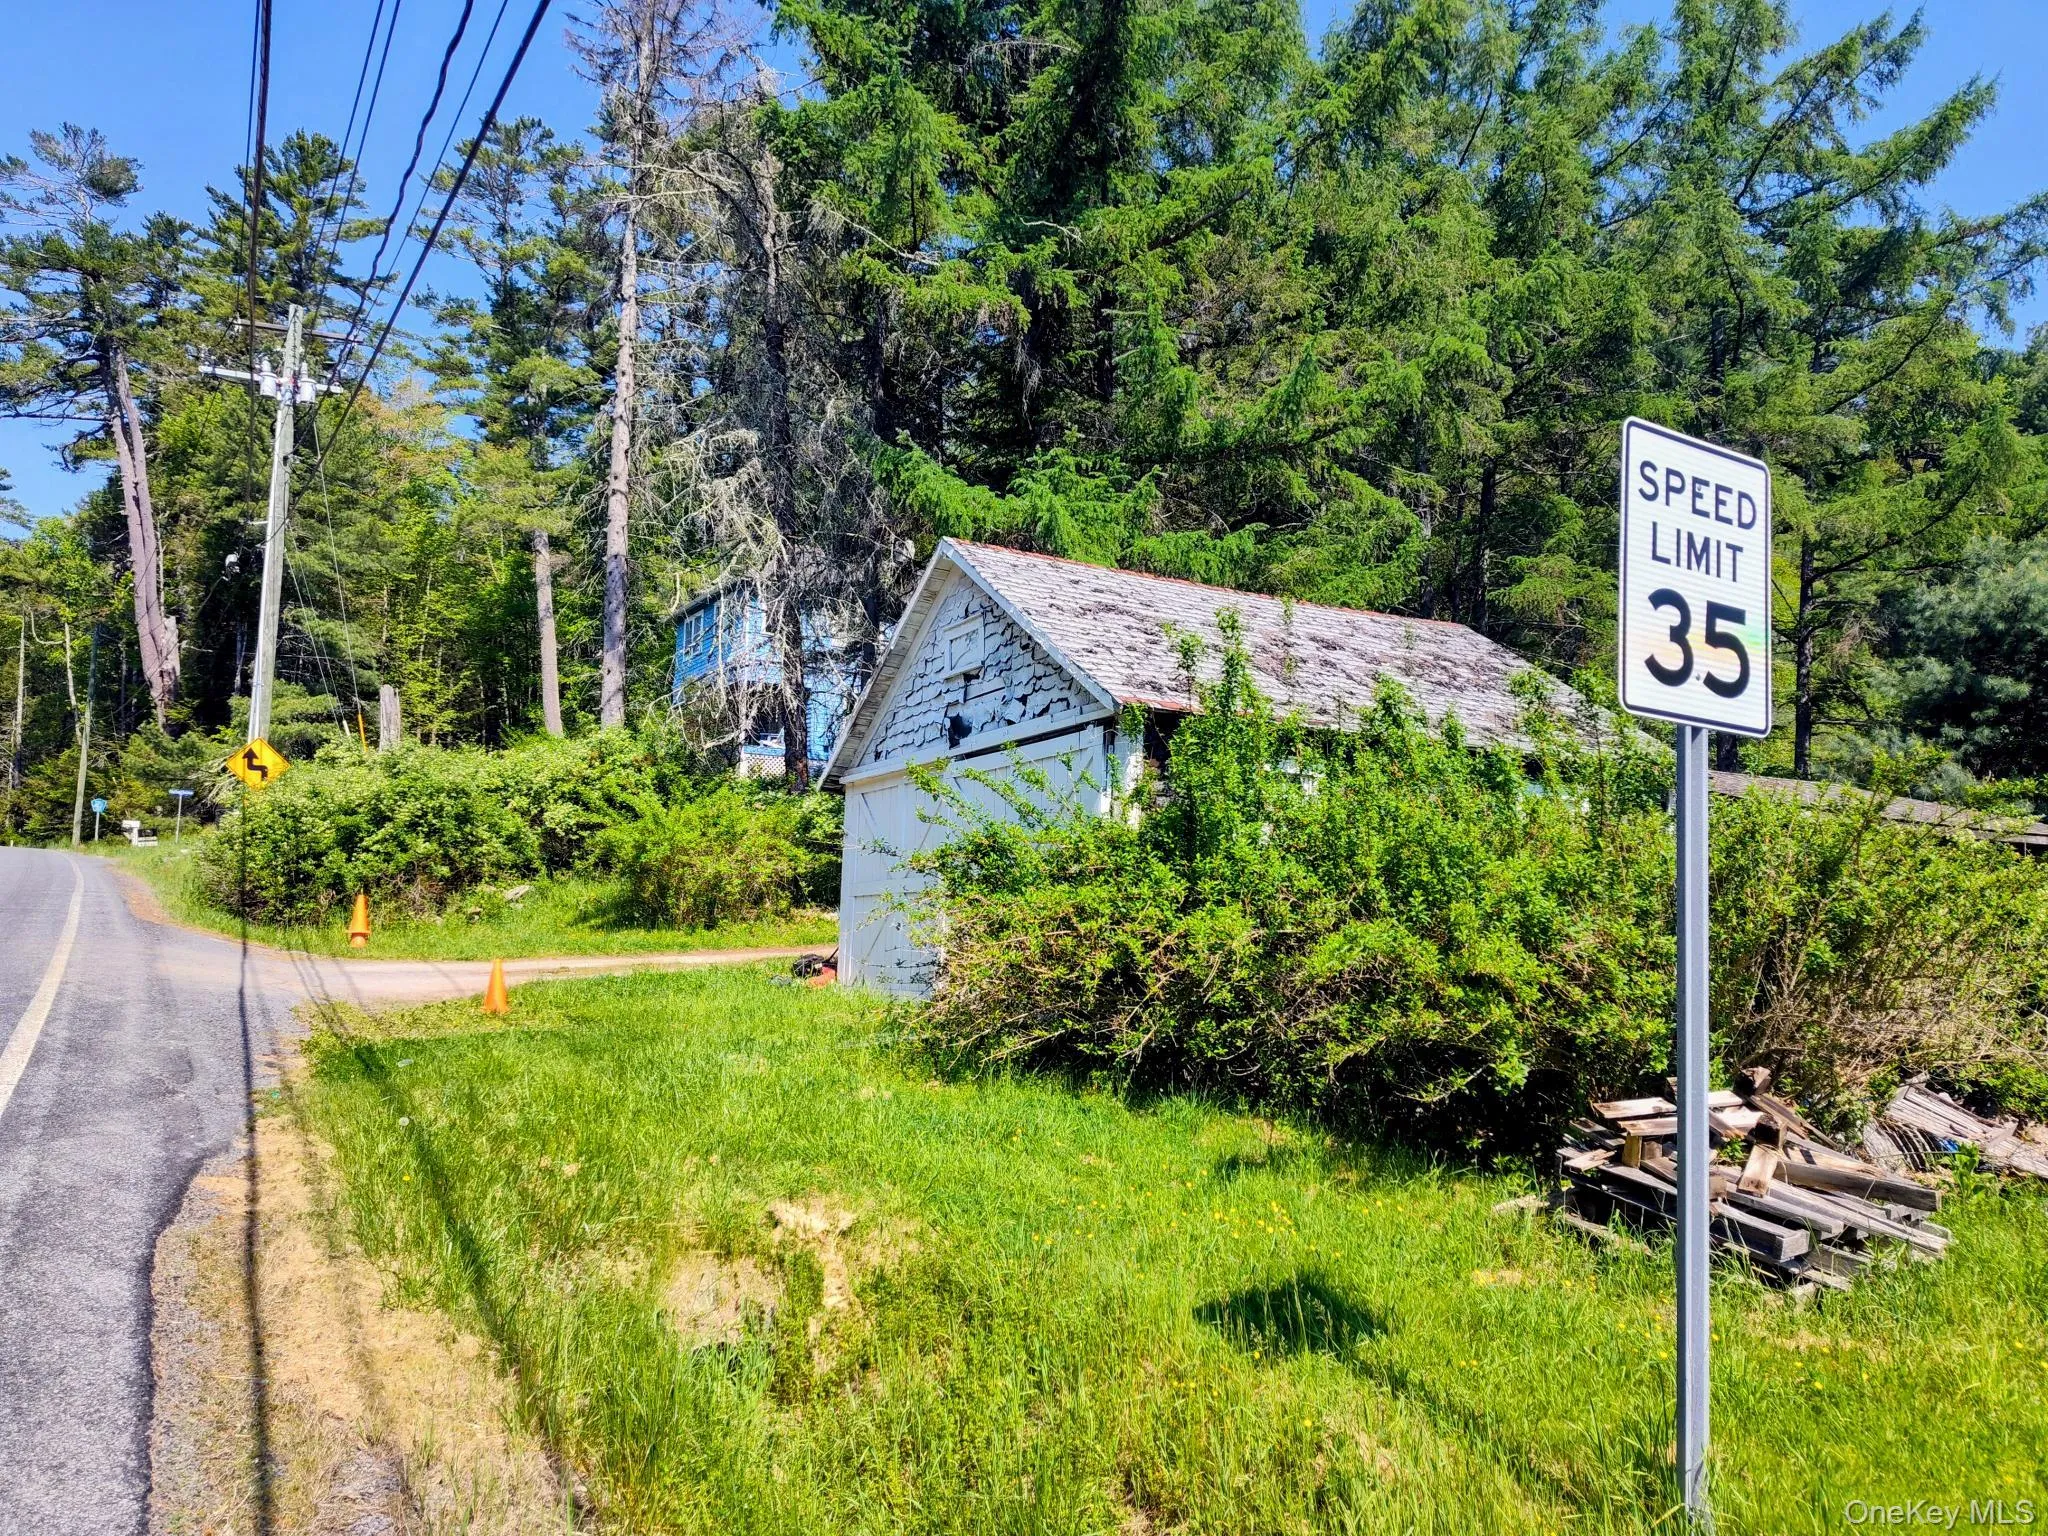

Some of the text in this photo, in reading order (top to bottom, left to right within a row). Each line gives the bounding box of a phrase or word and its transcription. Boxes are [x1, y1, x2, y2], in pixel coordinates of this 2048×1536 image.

[1638, 460, 1757, 530] SPEED
[1652, 521, 1744, 582] LIMIT
[1644, 588, 1750, 699] 35
